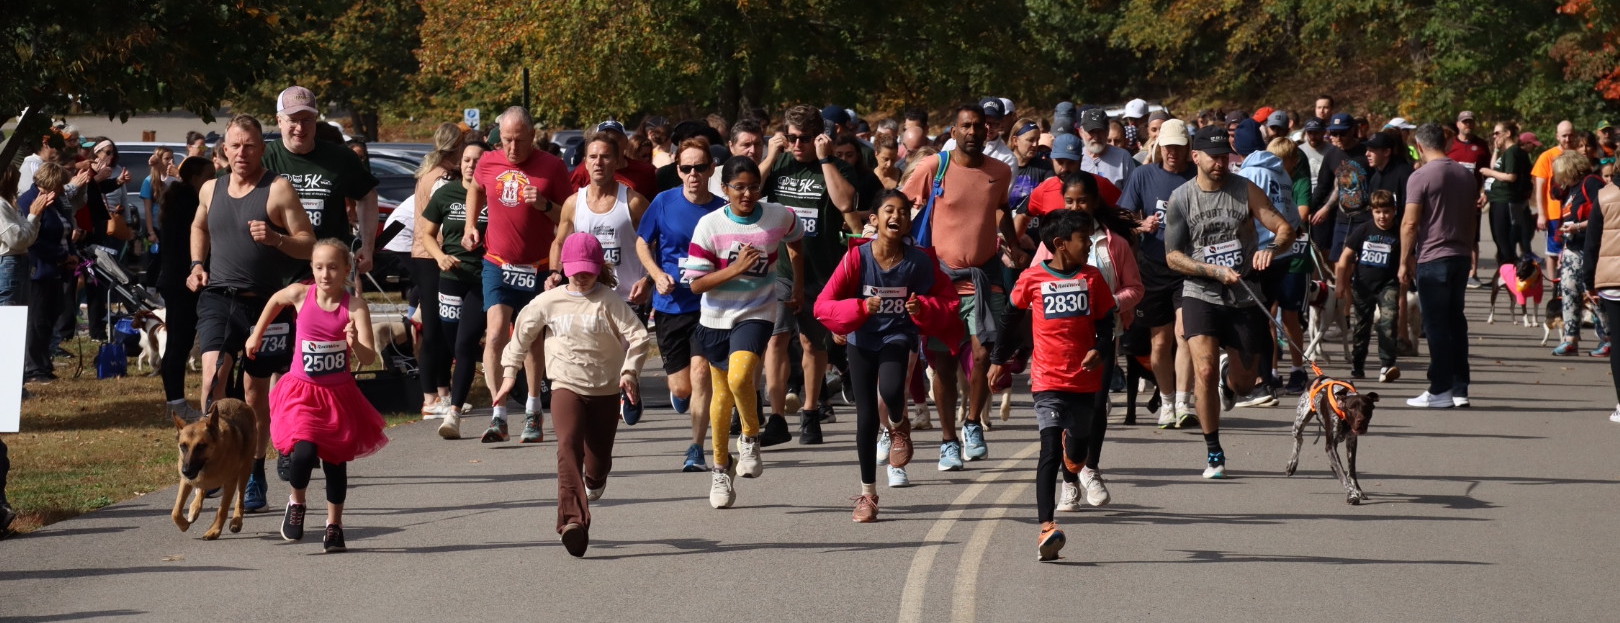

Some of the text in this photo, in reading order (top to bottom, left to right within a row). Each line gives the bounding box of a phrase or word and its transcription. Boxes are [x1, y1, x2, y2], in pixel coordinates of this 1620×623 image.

[304, 174, 322, 188] 5K
[798, 178, 815, 193] 5K
[1292, 242, 1307, 254] 97
[603, 249, 620, 263] 45
[1361, 250, 1388, 265] 2601
[502, 271, 535, 288] 2756
[1044, 293, 1088, 314] 2830
[261, 335, 287, 353] 734
[303, 353, 346, 372] 2508
